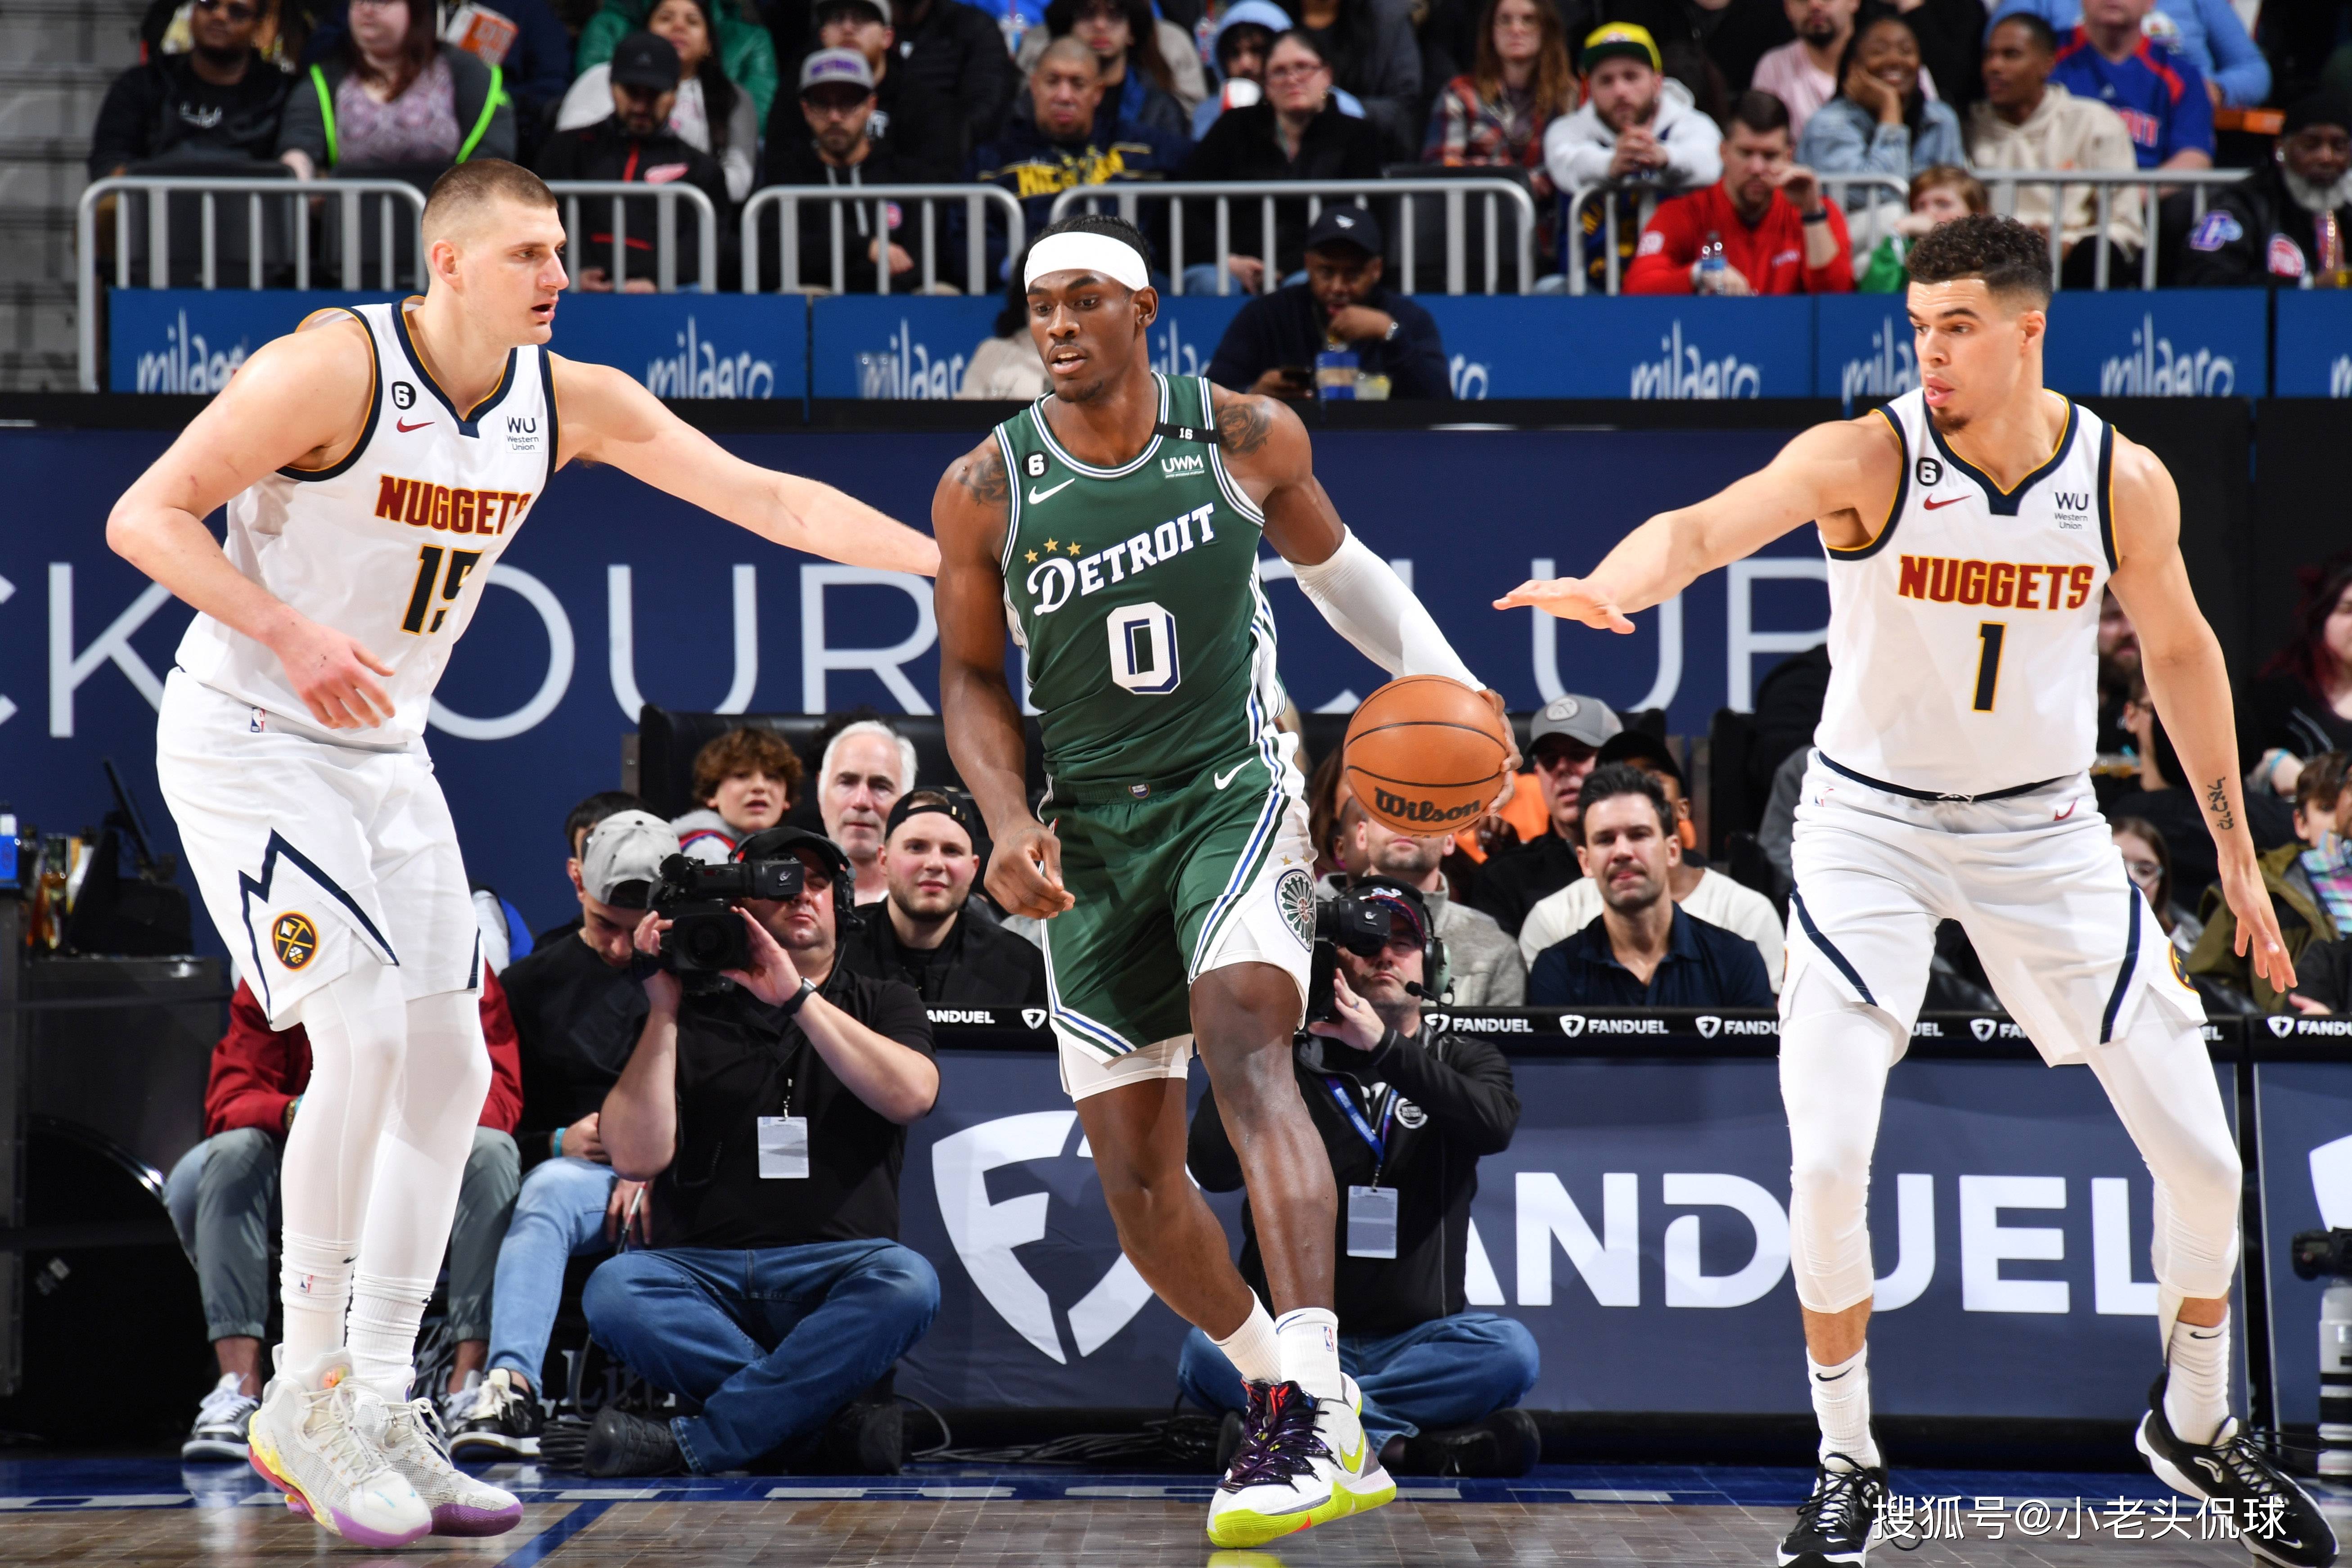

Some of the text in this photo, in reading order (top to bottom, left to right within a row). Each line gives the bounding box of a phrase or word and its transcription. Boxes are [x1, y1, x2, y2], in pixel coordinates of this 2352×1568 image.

[394, 385, 410, 406] 6
[507, 416, 536, 433] WU
[1179, 428, 1193, 440] 16
[506, 435, 539, 443] Western
[1028, 454, 1045, 476] 6
[1161, 454, 1203, 473] UWM
[1919, 461, 1938, 484] 6
[2055, 492, 2089, 511] WU
[2054, 513, 2088, 522] Western
[2059, 522, 2082, 530] Union
[1027, 502, 1215, 617] DETROIT
[400, 543, 485, 636] 15
[1897, 553, 2096, 611] NUGGETS
[1106, 601, 1181, 695] 0
[1971, 620, 2007, 714] 1
[1374, 785, 1481, 823] Wilson
[926, 1009, 996, 1024] ANDUEL
[1452, 1018, 1534, 1033] FANDUEL
[1588, 1019, 1670, 1034] FANDUEL
[1724, 1020, 1780, 1035] FANDU
